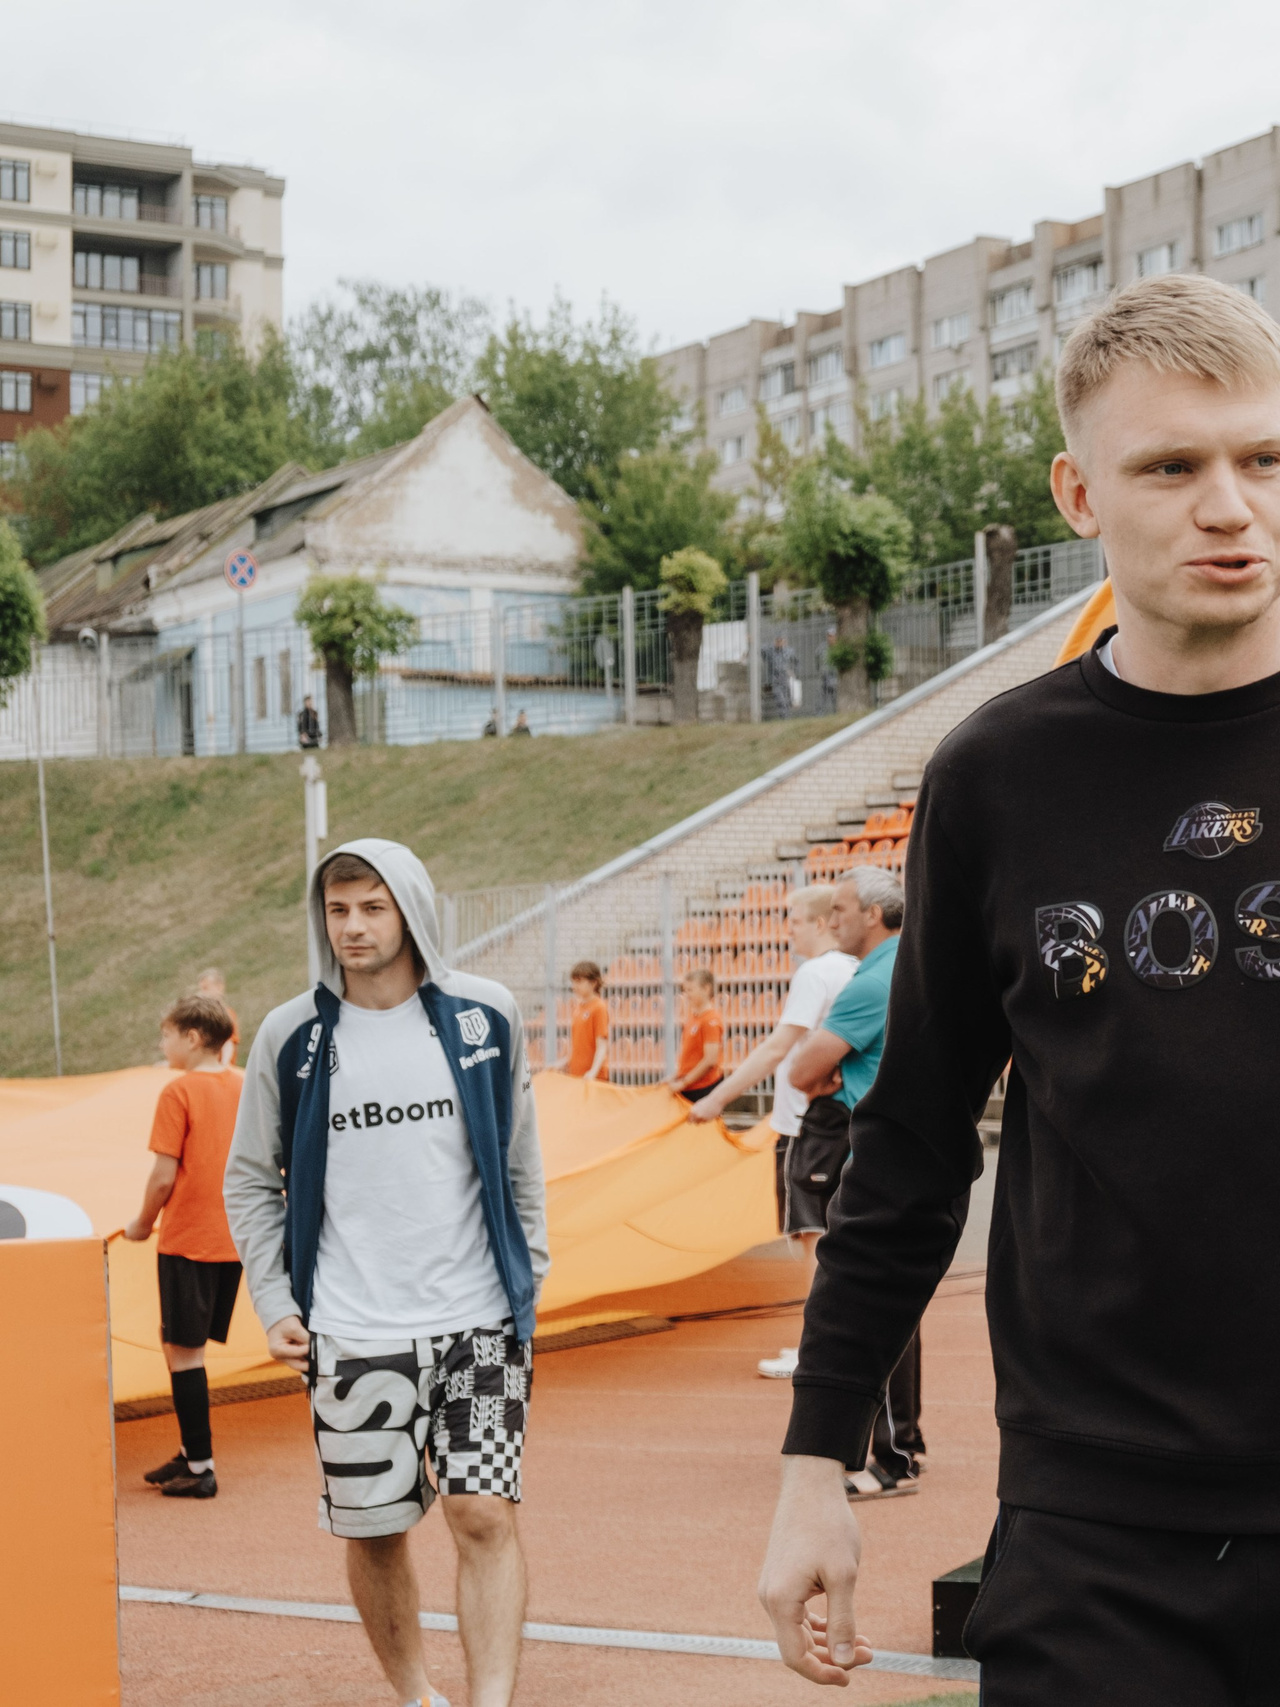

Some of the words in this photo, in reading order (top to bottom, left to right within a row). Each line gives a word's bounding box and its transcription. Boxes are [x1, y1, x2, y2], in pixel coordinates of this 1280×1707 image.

[1212, 811, 1255, 820] ANGELES
[1171, 818, 1255, 845] LAKERS
[327, 1098, 454, 1131] etBoom
